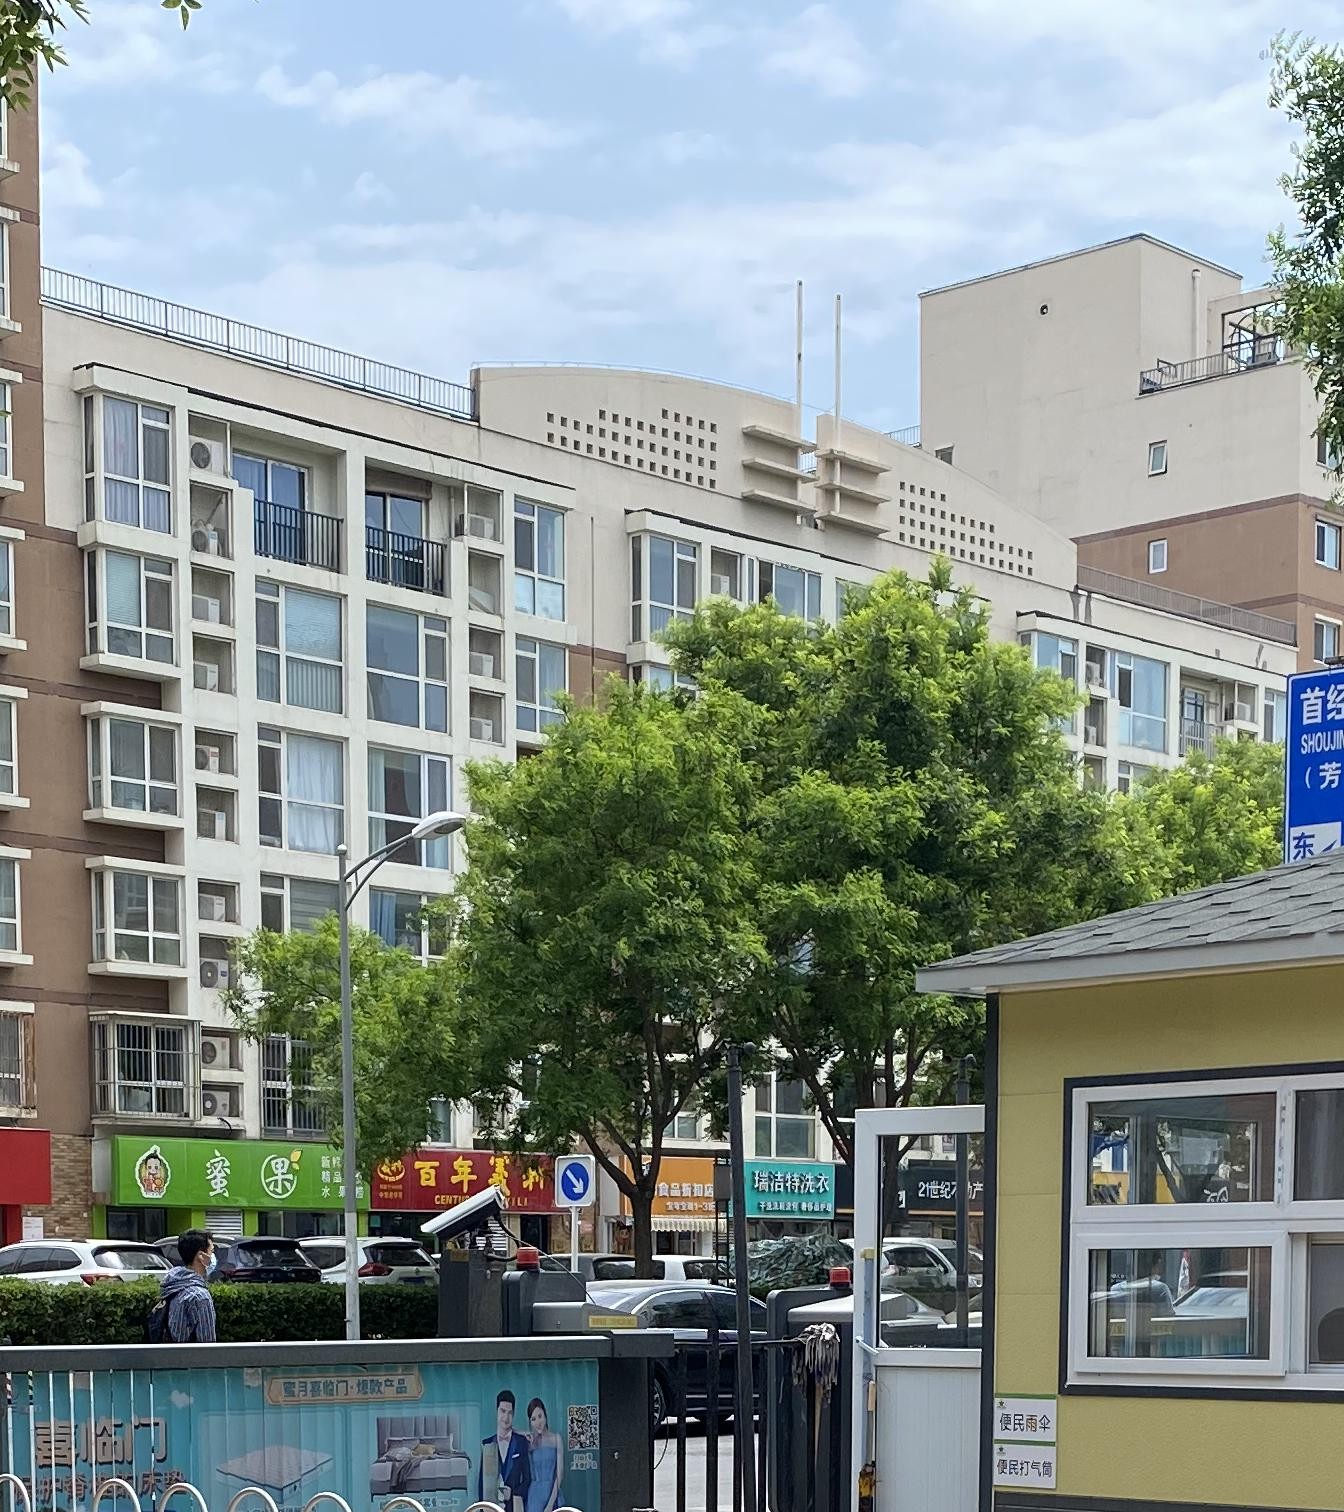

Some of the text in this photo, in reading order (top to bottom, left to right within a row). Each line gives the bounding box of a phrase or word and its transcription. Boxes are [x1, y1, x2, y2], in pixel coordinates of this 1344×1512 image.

[1292, 831, 1316, 861] 东
[754, 1171, 830, 1194] 瑞洁特洗衣
[999, 1412, 1051, 1433] 便民雨伞
[33, 1416, 170, 1470] 喜临门
[996, 1459, 1053, 1478] 便民打气筒
